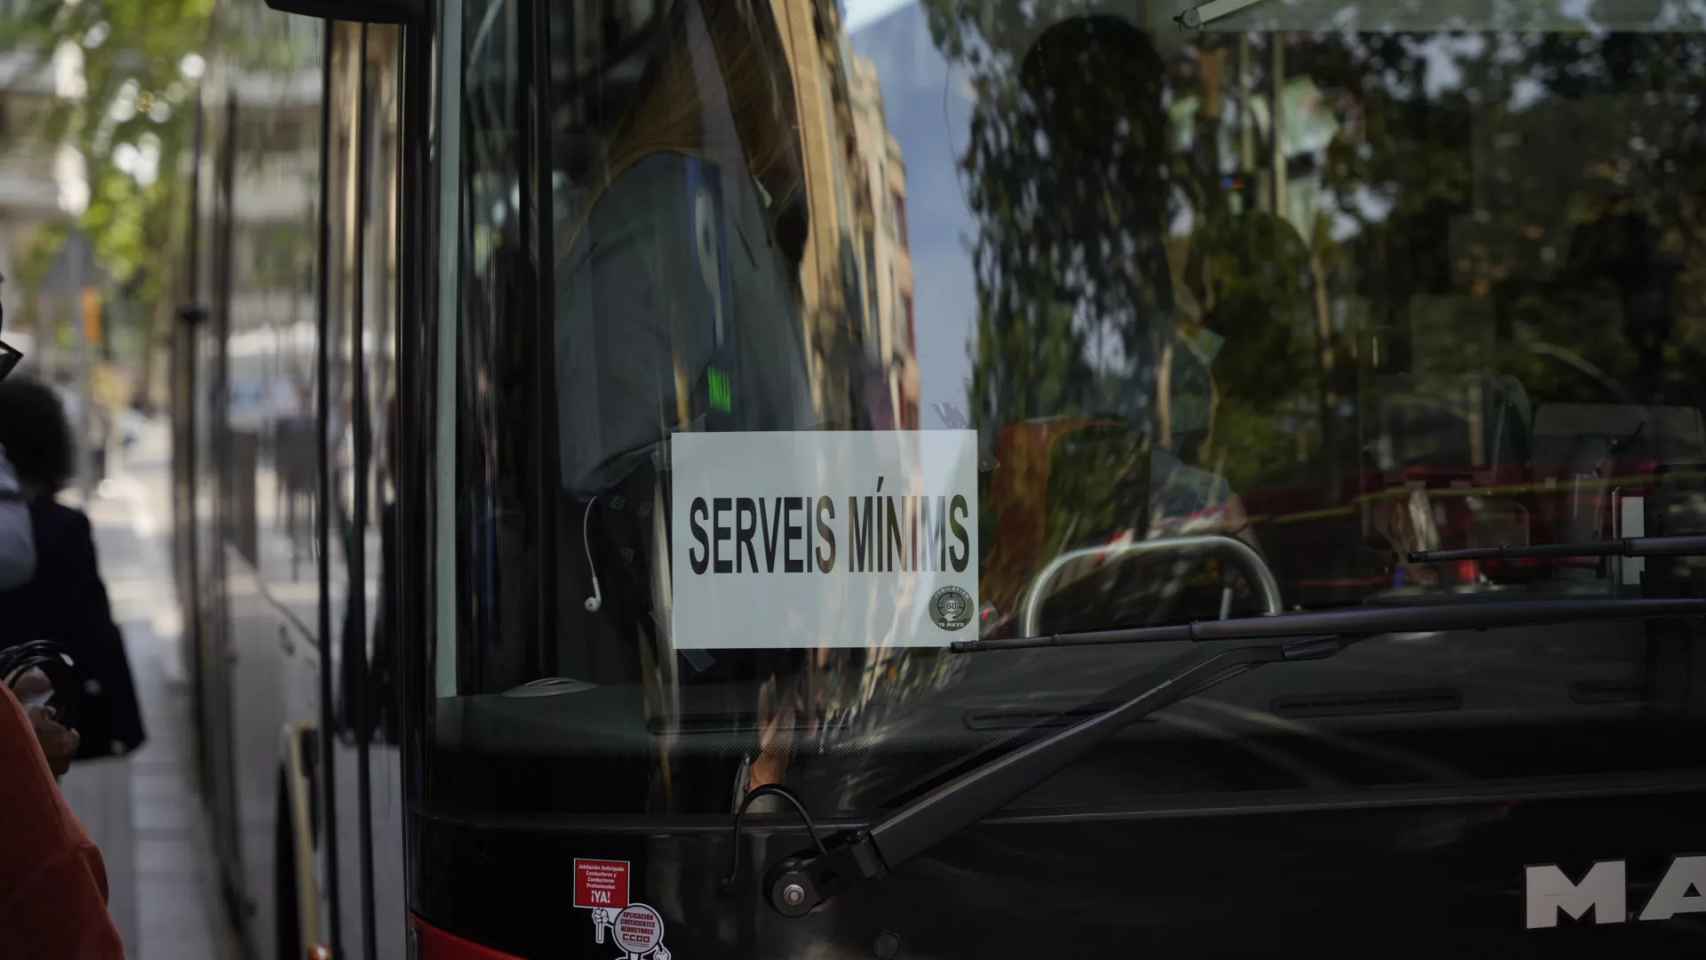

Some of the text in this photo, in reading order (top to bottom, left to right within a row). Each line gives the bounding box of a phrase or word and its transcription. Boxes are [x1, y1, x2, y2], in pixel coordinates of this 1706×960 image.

[688, 476, 970, 575] SERVEIS MÍNIMS
[591, 890, 611, 903] ¡YA!
